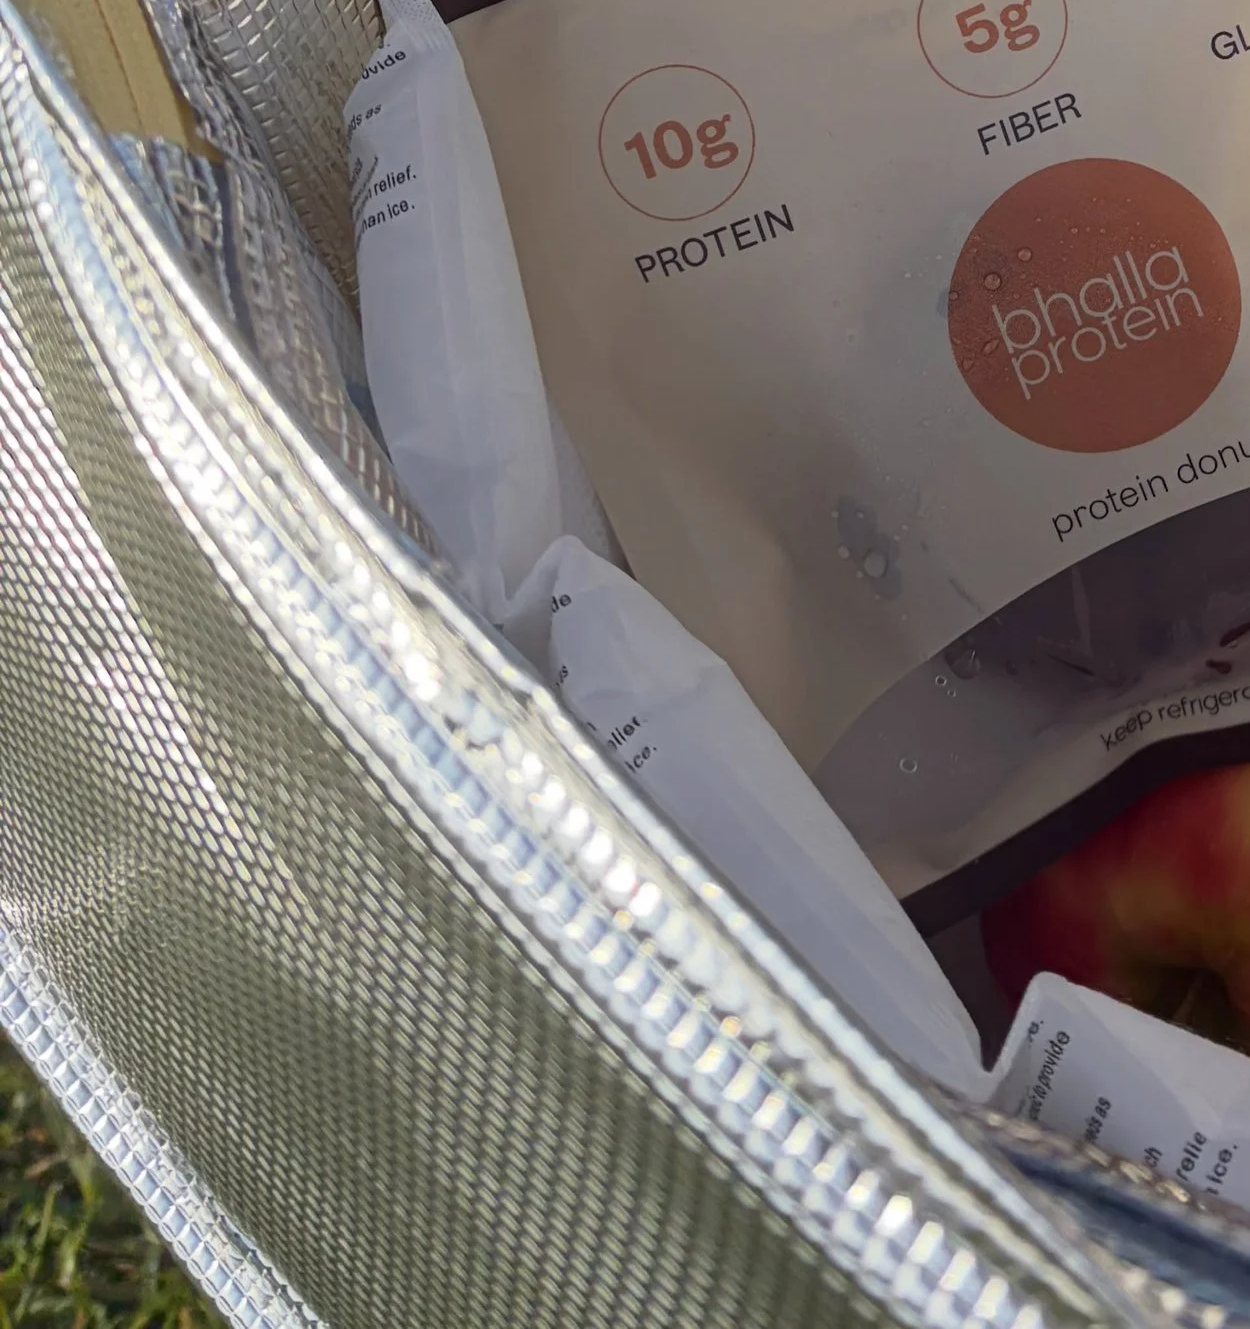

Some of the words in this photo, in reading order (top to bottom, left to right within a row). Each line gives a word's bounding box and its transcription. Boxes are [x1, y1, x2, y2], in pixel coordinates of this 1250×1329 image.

[623, 113, 740, 180] 10g
[977, 93, 1083, 156] FIBER
[634, 203, 795, 284] PROTEIN
[991, 246, 1190, 355] bhalla
[1011, 285, 1204, 401] protein
[1051, 474, 1169, 543] protein
[1175, 1132, 1208, 1182] relie
